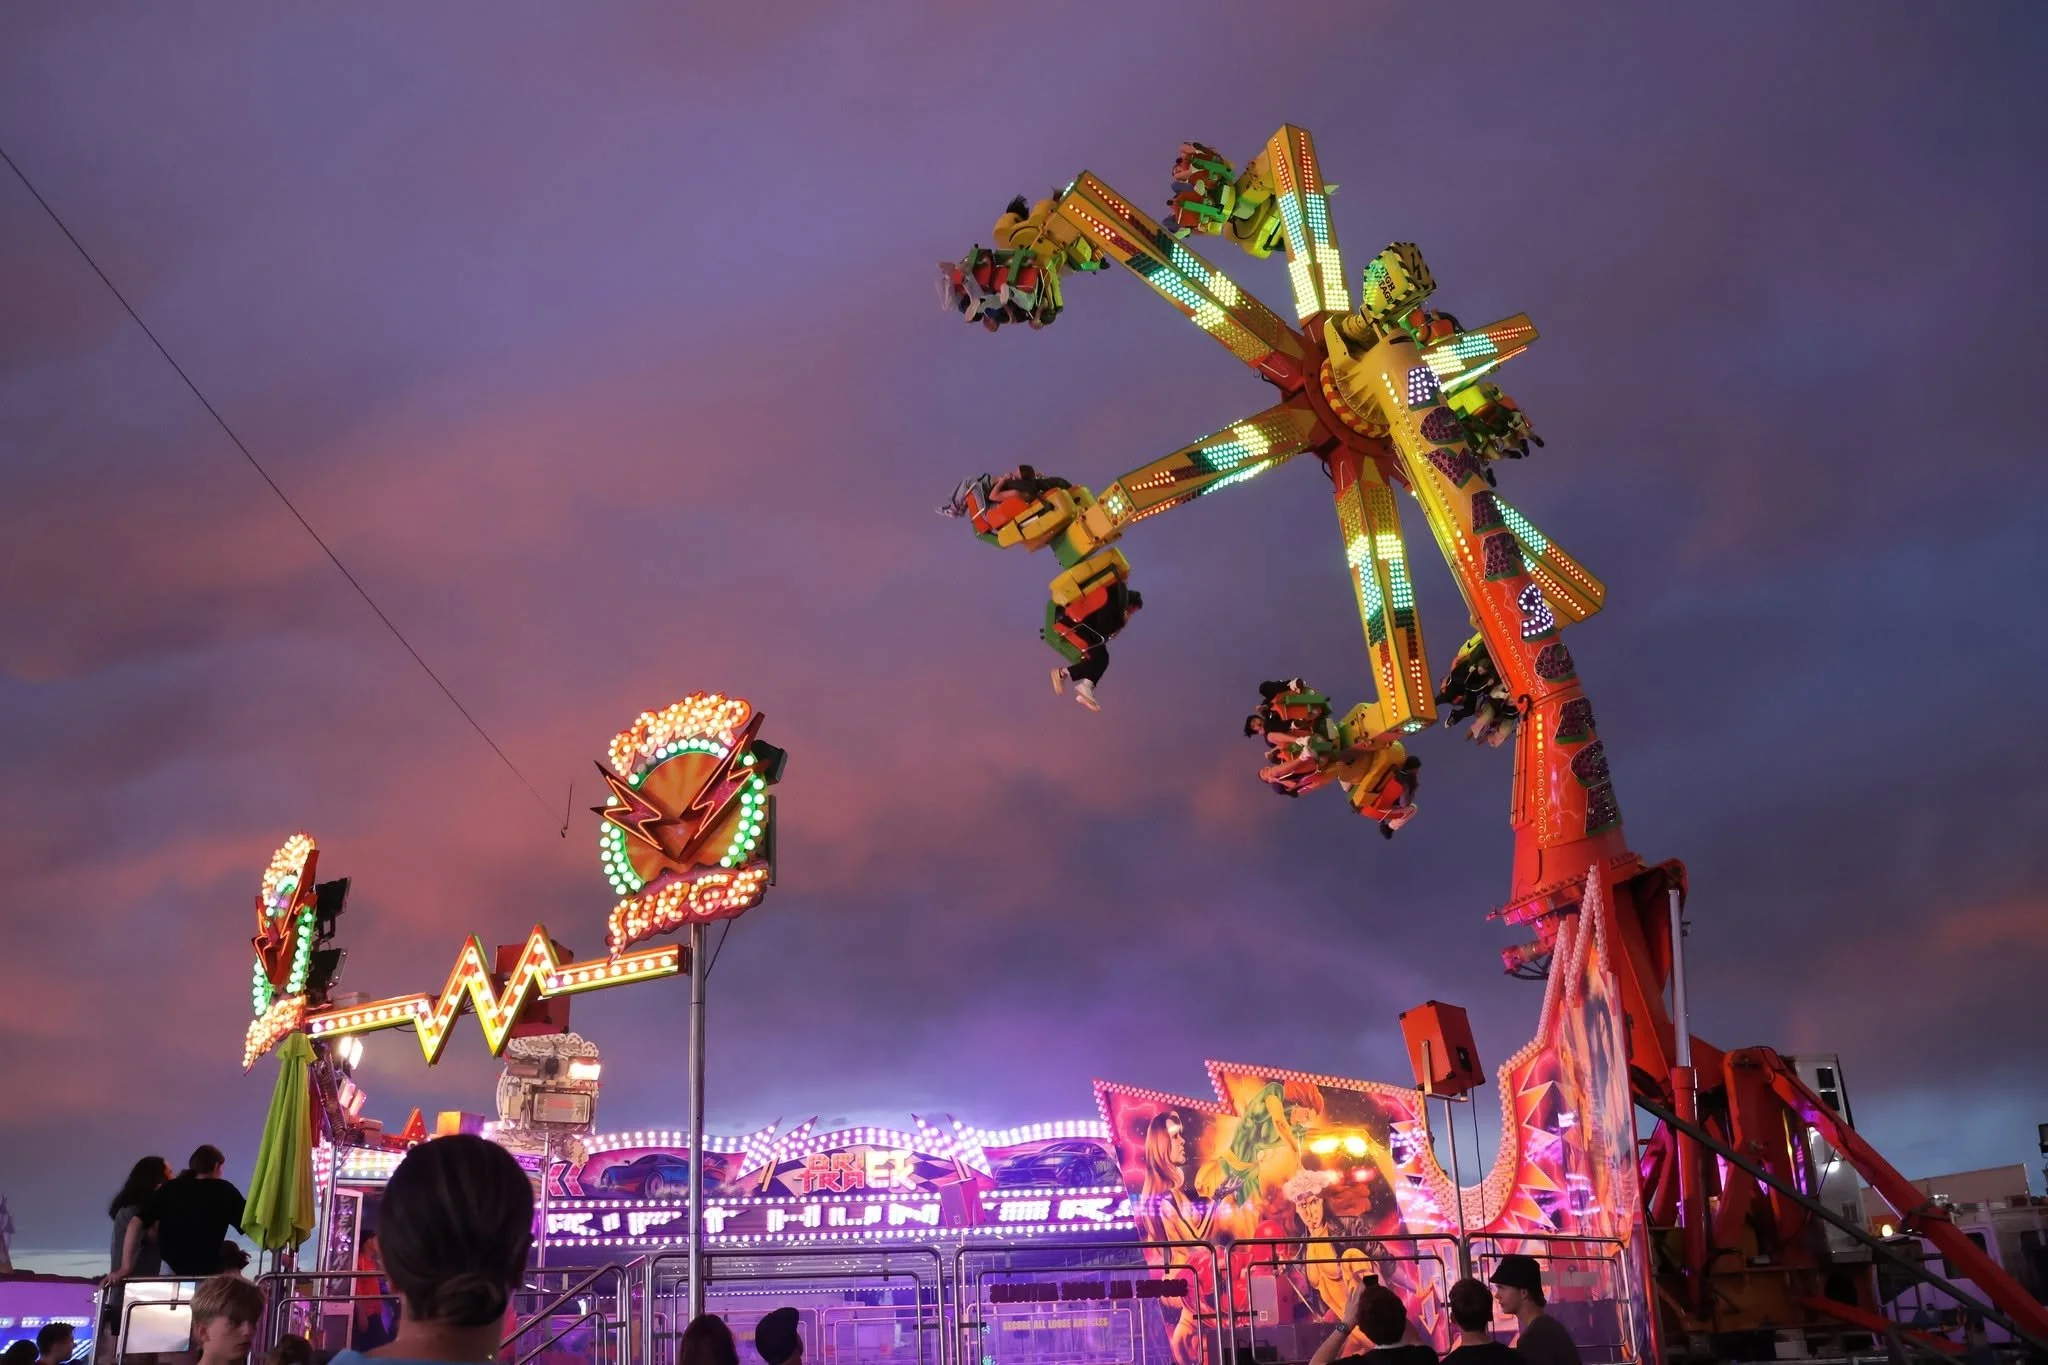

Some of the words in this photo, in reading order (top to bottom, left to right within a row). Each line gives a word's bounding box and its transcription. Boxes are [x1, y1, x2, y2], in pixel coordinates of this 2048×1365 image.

[546, 1206, 745, 1236] RIFT
[766, 1198, 1134, 1233] HUNER
[1033, 1319, 1046, 1330] ALL
[1073, 1317, 1109, 1328] ARTLES
